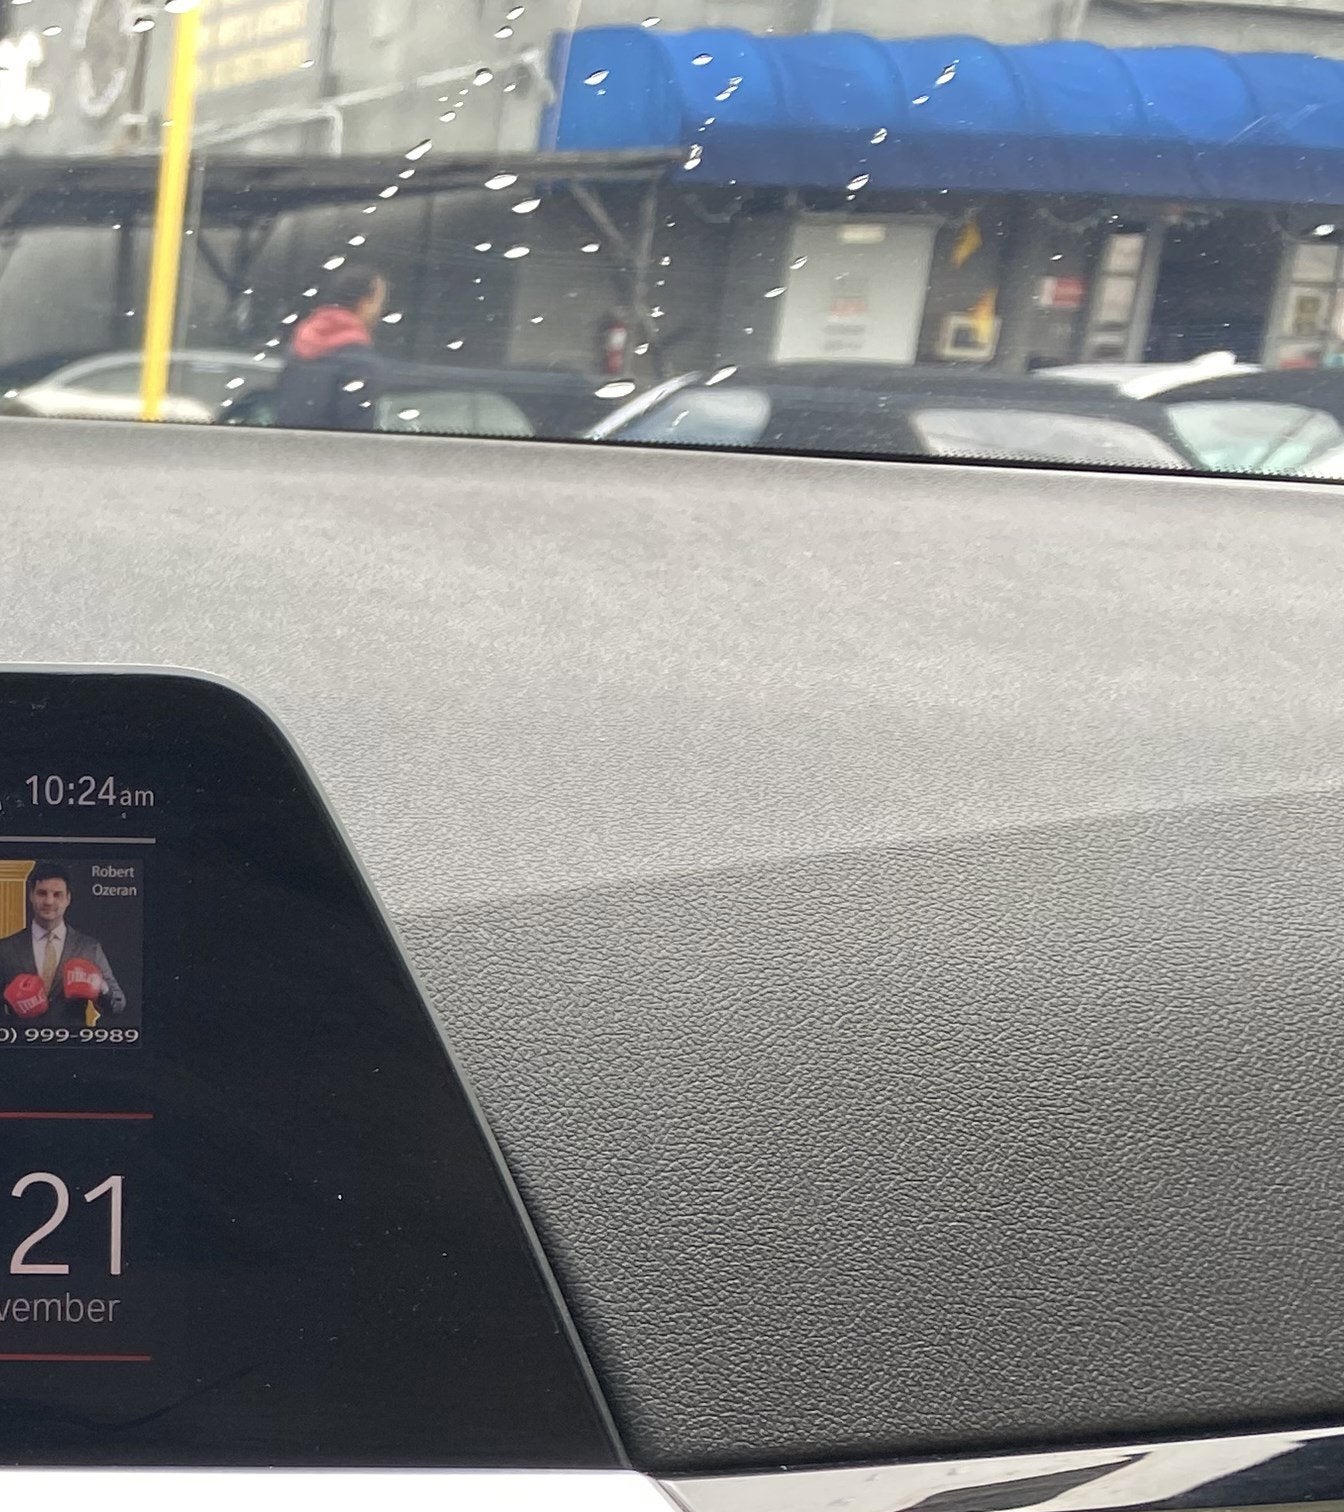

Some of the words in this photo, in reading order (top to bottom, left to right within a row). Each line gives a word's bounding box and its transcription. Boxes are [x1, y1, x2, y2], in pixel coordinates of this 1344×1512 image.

[92, 866, 134, 877] Robert
[92, 884, 137, 896] Ozeran
[25, 1029, 138, 1042] 999-9989
[10, 1173, 122, 1274] 21
